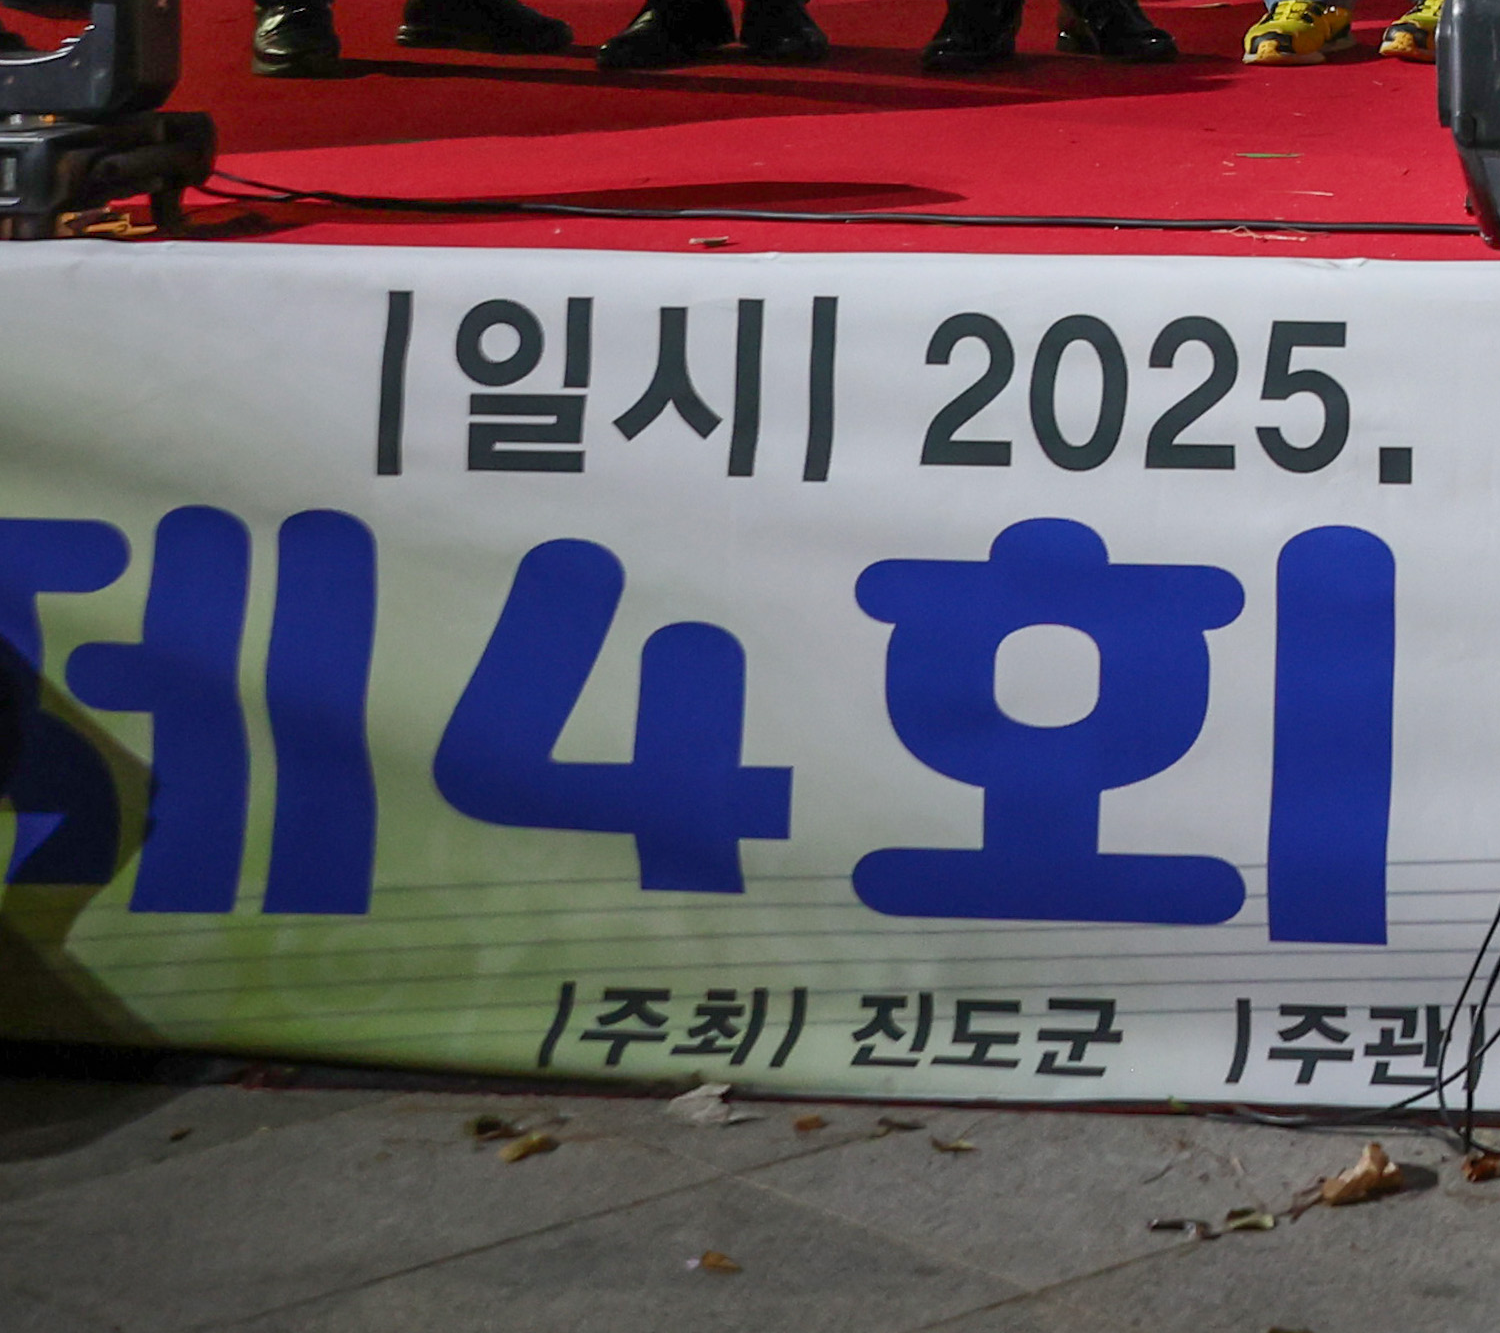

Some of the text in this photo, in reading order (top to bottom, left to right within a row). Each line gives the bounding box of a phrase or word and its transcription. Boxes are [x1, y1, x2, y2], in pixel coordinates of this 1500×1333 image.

[920, 313, 1413, 485] 2025.
[0, 504, 1396, 946] 제4회
[850, 993, 1124, 1079] 진도군
